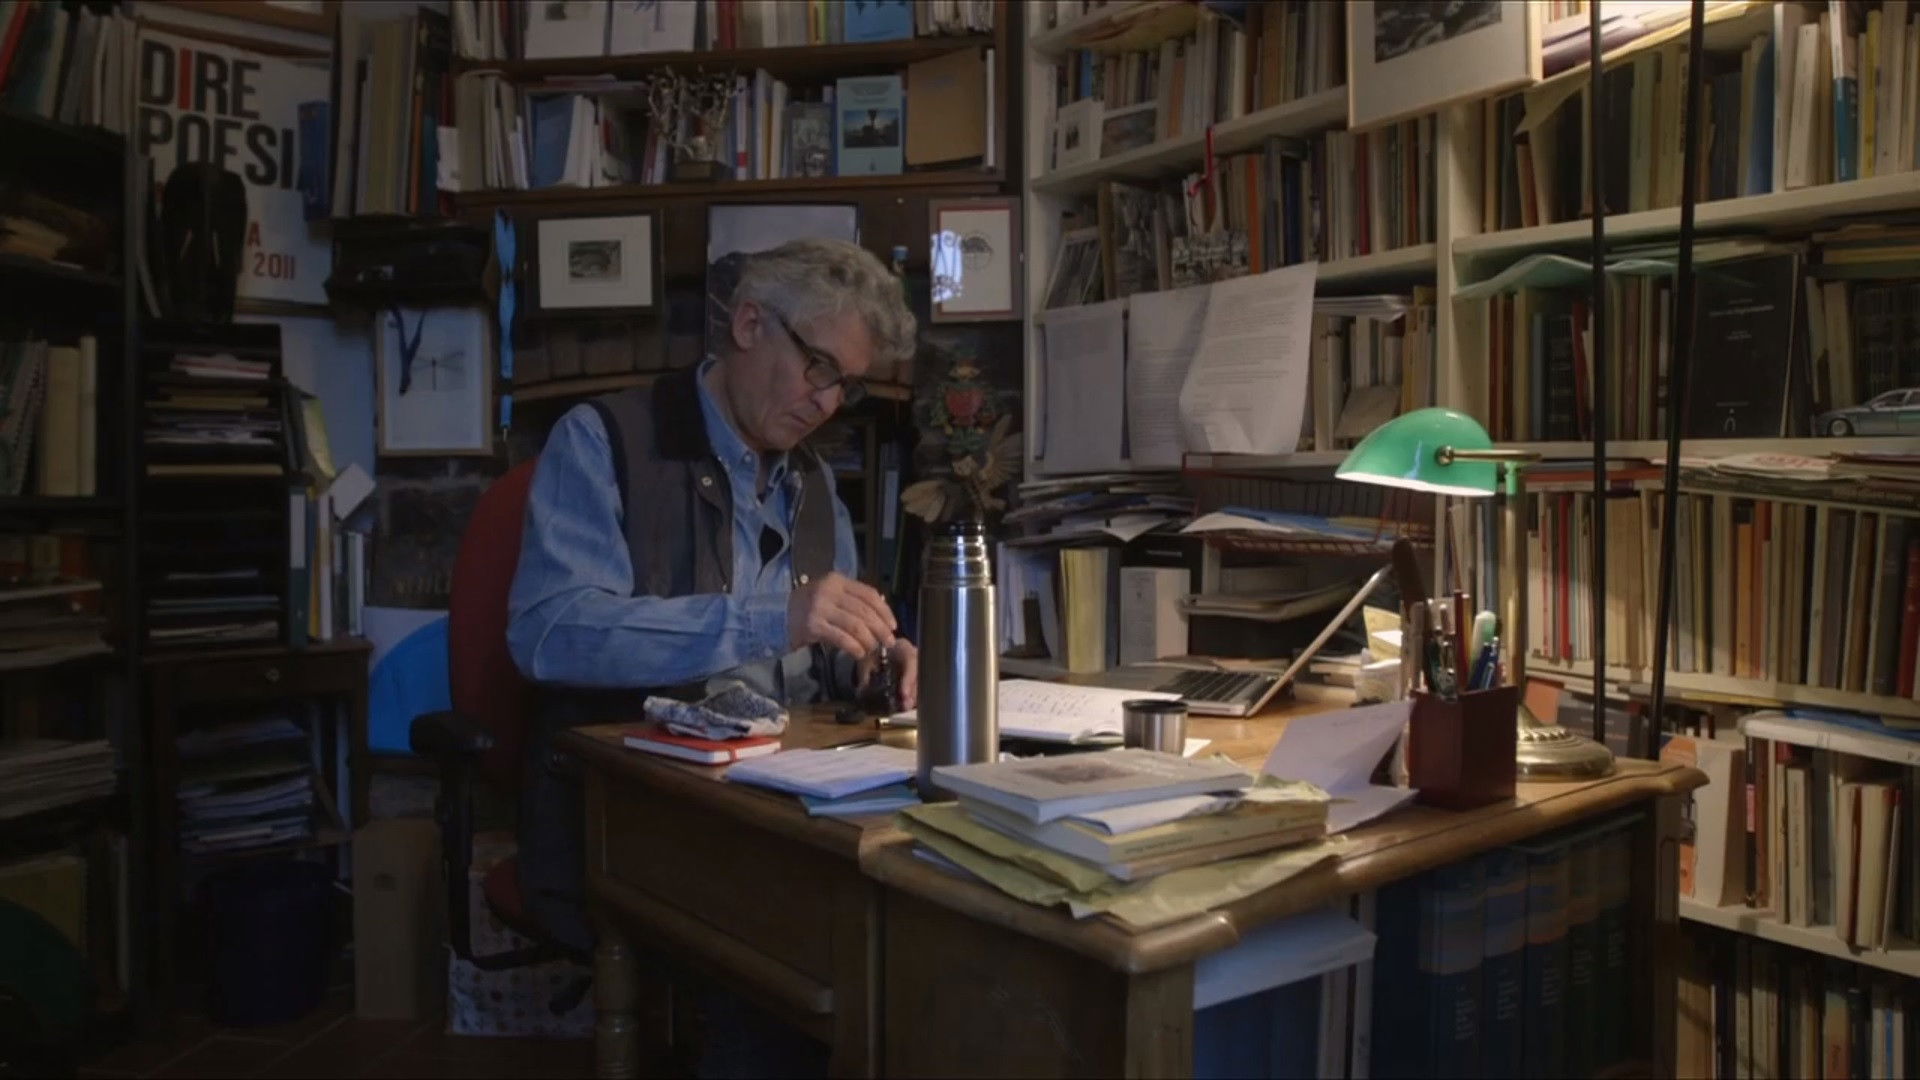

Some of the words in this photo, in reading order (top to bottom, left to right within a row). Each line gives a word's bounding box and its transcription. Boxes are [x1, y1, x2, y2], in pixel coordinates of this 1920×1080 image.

[140, 39, 261, 121] DIRE
[138, 106, 302, 190] POESI
[253, 252, 296, 281] 2011
